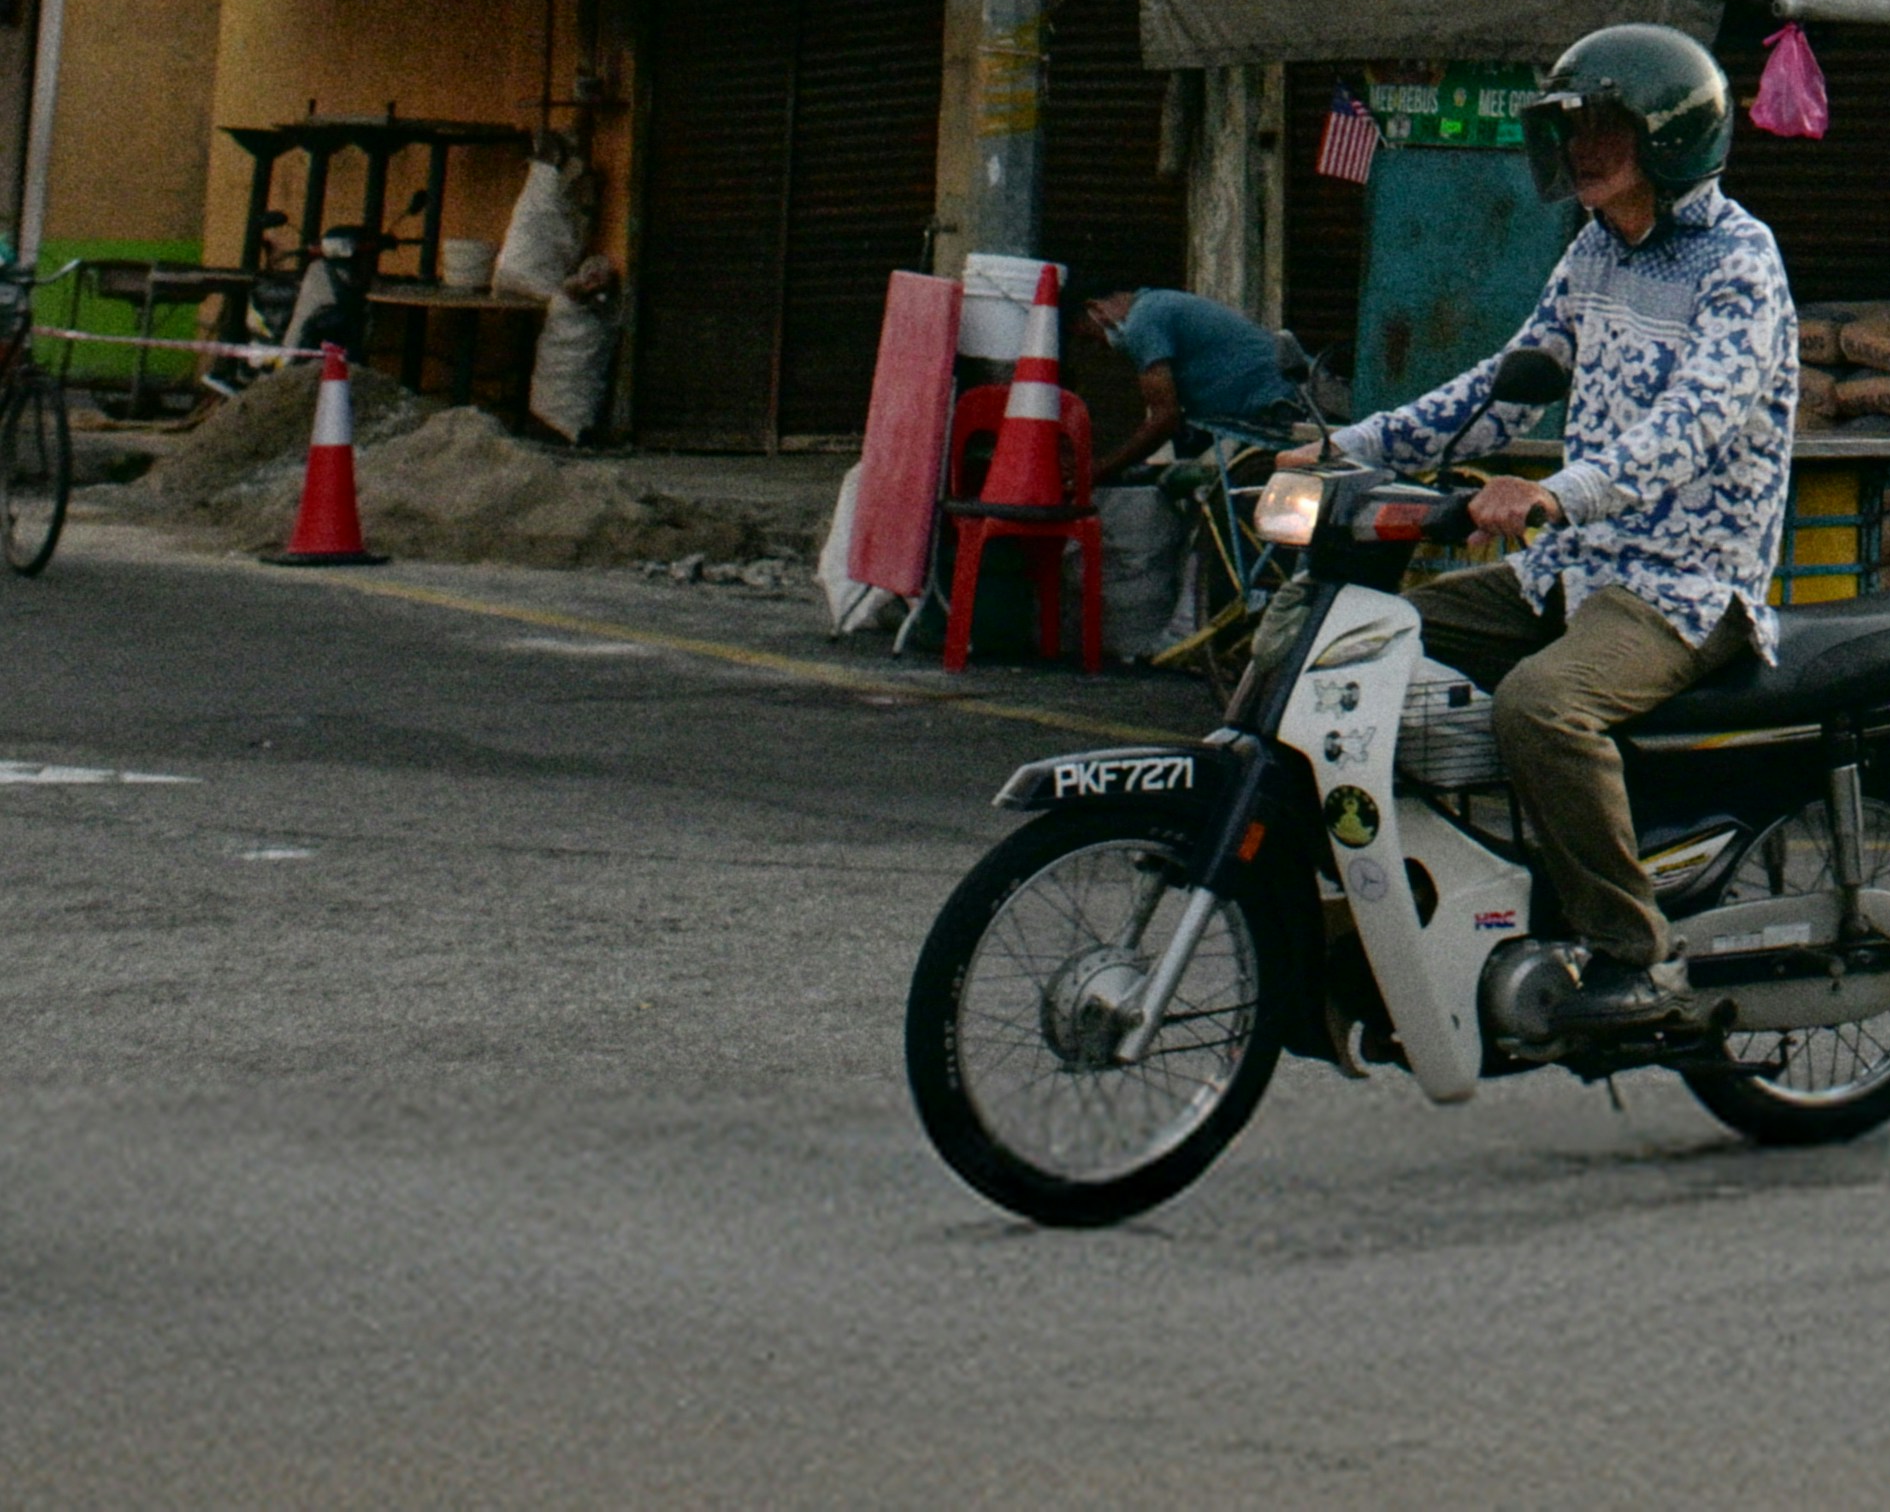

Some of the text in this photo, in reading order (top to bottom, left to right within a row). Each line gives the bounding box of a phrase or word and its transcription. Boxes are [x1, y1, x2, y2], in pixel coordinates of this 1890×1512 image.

[1399, 86, 1440, 114] REBUS
[1478, 89, 1506, 118] MEE
[1054, 756, 1194, 797] PKF7271
[1474, 909, 1516, 931] HRC
